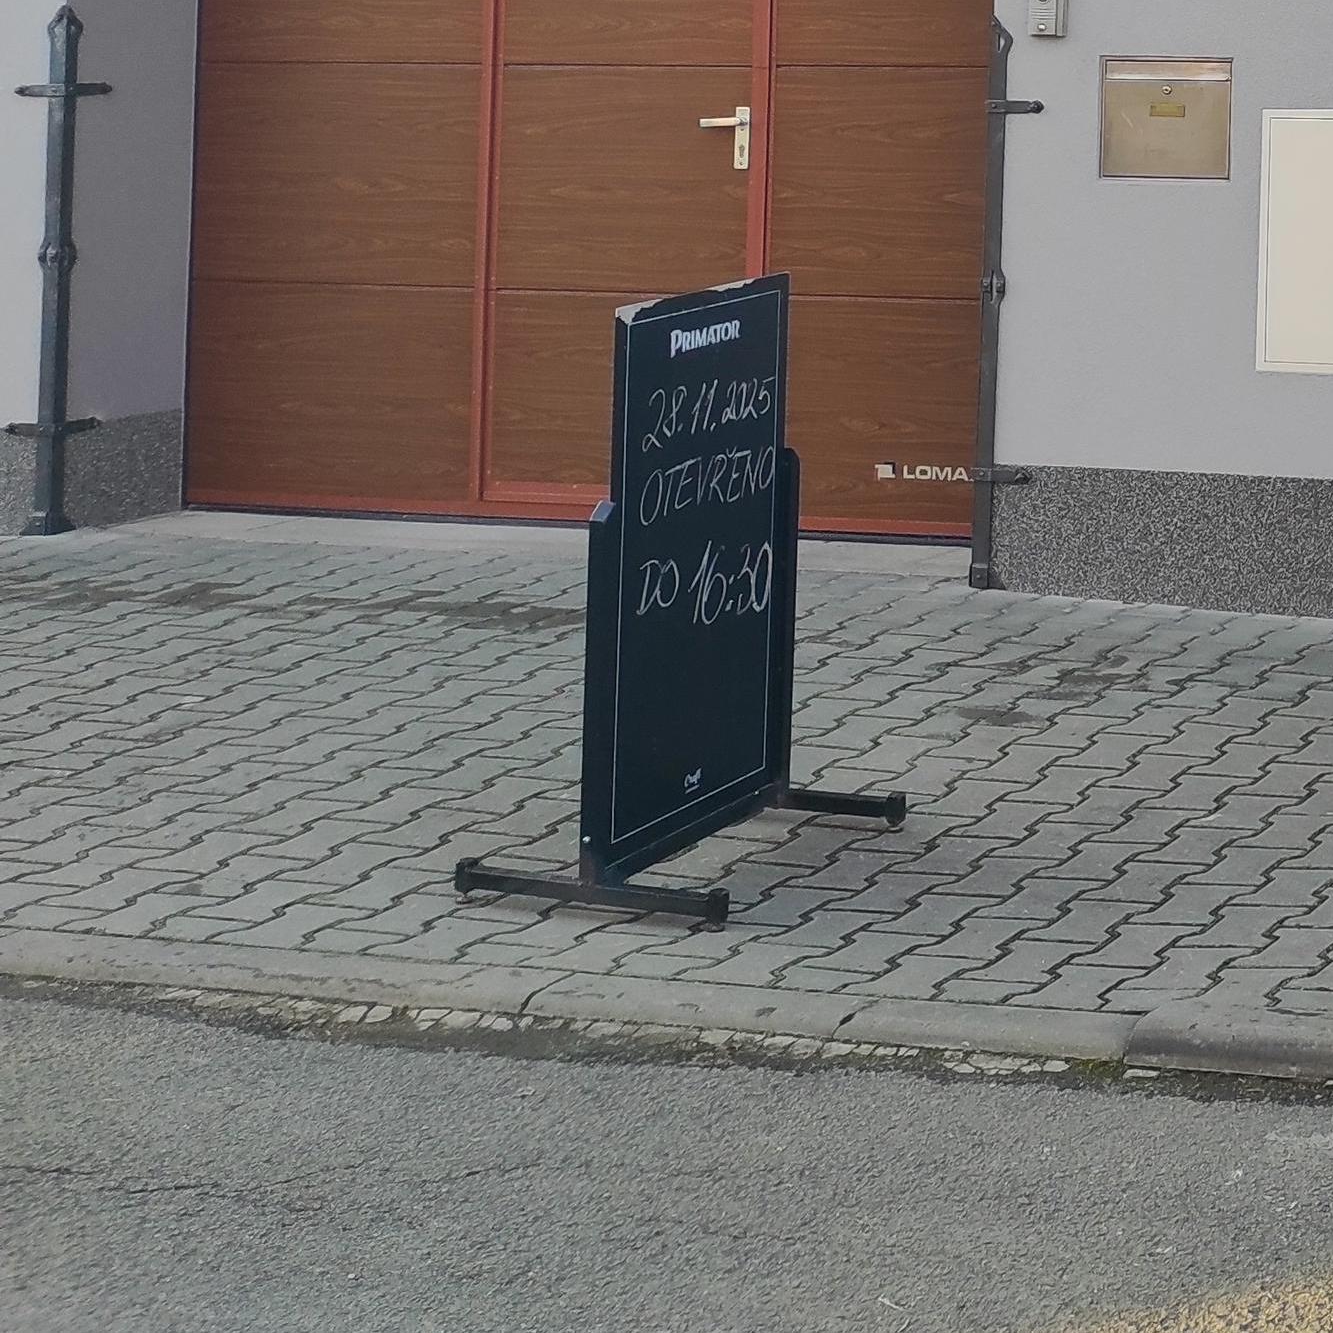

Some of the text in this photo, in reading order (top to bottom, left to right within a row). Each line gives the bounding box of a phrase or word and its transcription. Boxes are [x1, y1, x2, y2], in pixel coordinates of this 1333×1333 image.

[670, 319, 741, 359] PRIMATOR
[640, 446, 775, 526] OTEVŘENO
[902, 464, 975, 482] LOMA
[636, 539, 773, 625] DO 16:30
